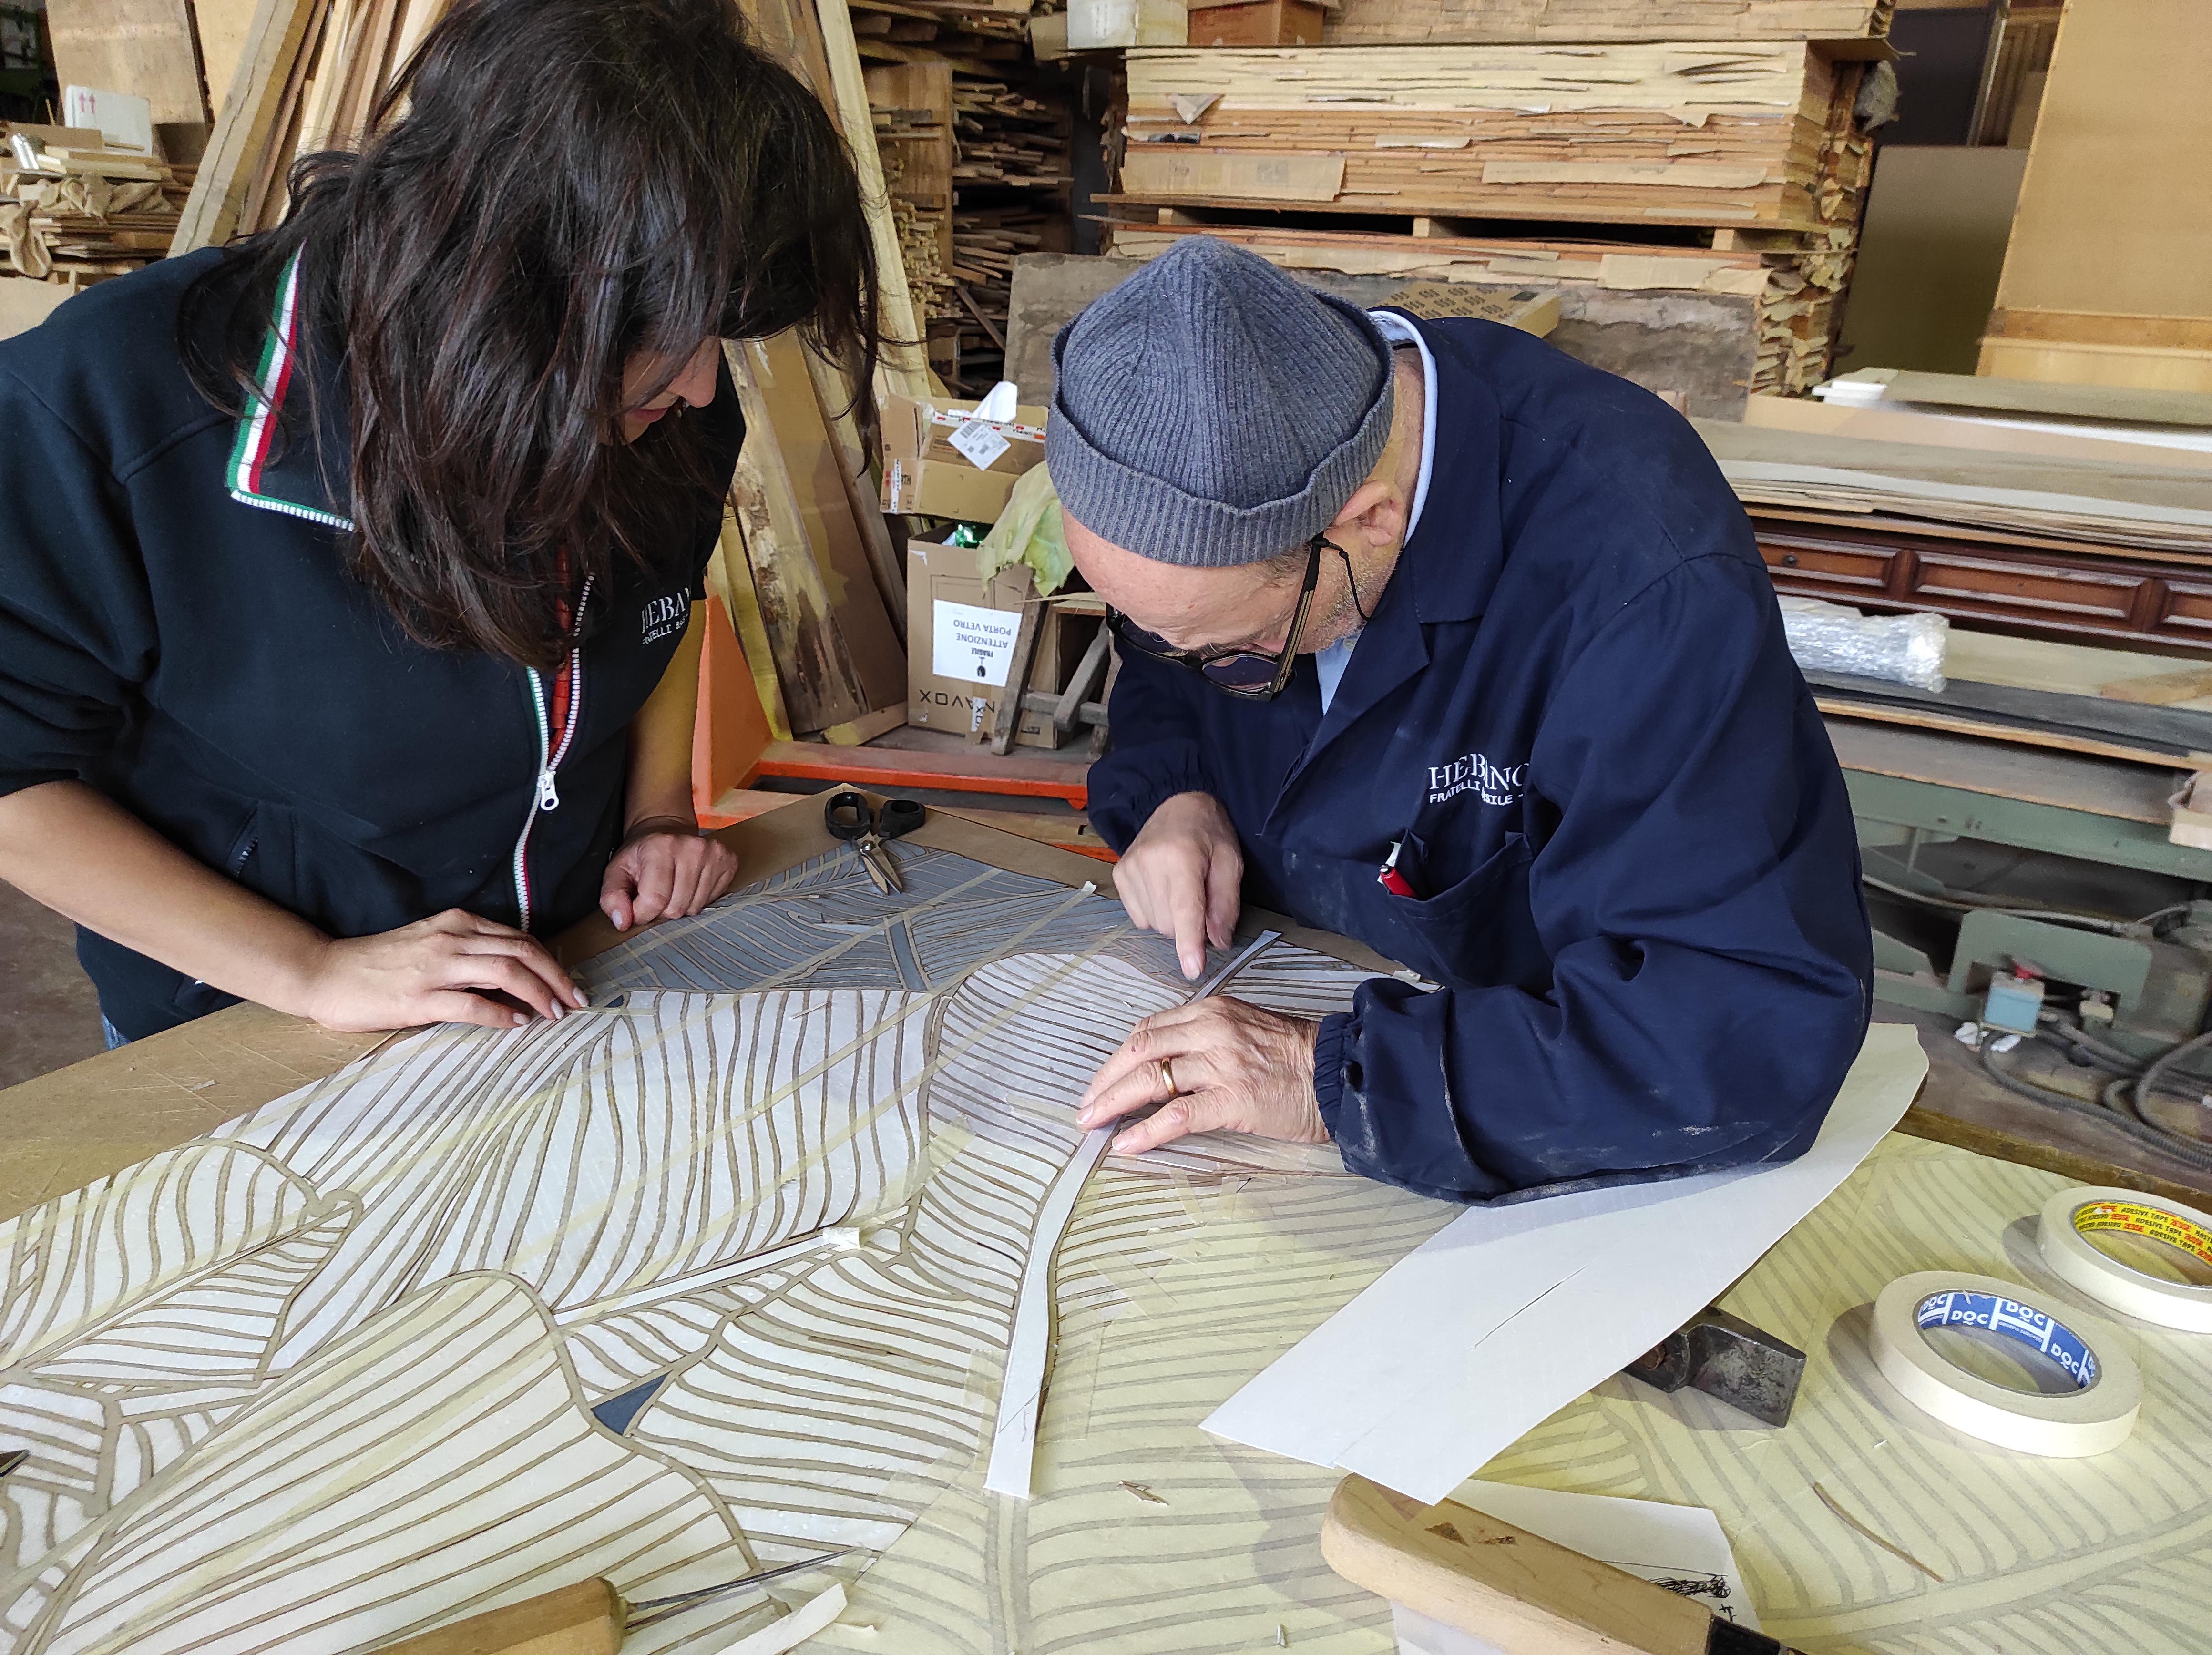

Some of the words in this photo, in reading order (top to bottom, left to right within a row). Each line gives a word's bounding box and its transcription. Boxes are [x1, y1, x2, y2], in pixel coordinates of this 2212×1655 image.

[642, 587, 690, 634] HEBA
[953, 619, 981, 631] VETRO
[983, 625, 1011, 636] PORTA
[956, 633, 1008, 648] ATTENZIONE
[971, 648, 993, 657] FRAGILE
[1430, 779, 1481, 804] FRATELLI
[1481, 786, 1514, 806] SILE
[2151, 1213, 2169, 1222] TAPE
[2165, 1226, 2182, 1236] TAPE
[1951, 1310, 1989, 1325] DOC
[2006, 1301, 2046, 1326] DOC
[2051, 1343, 2079, 1374] DOC
